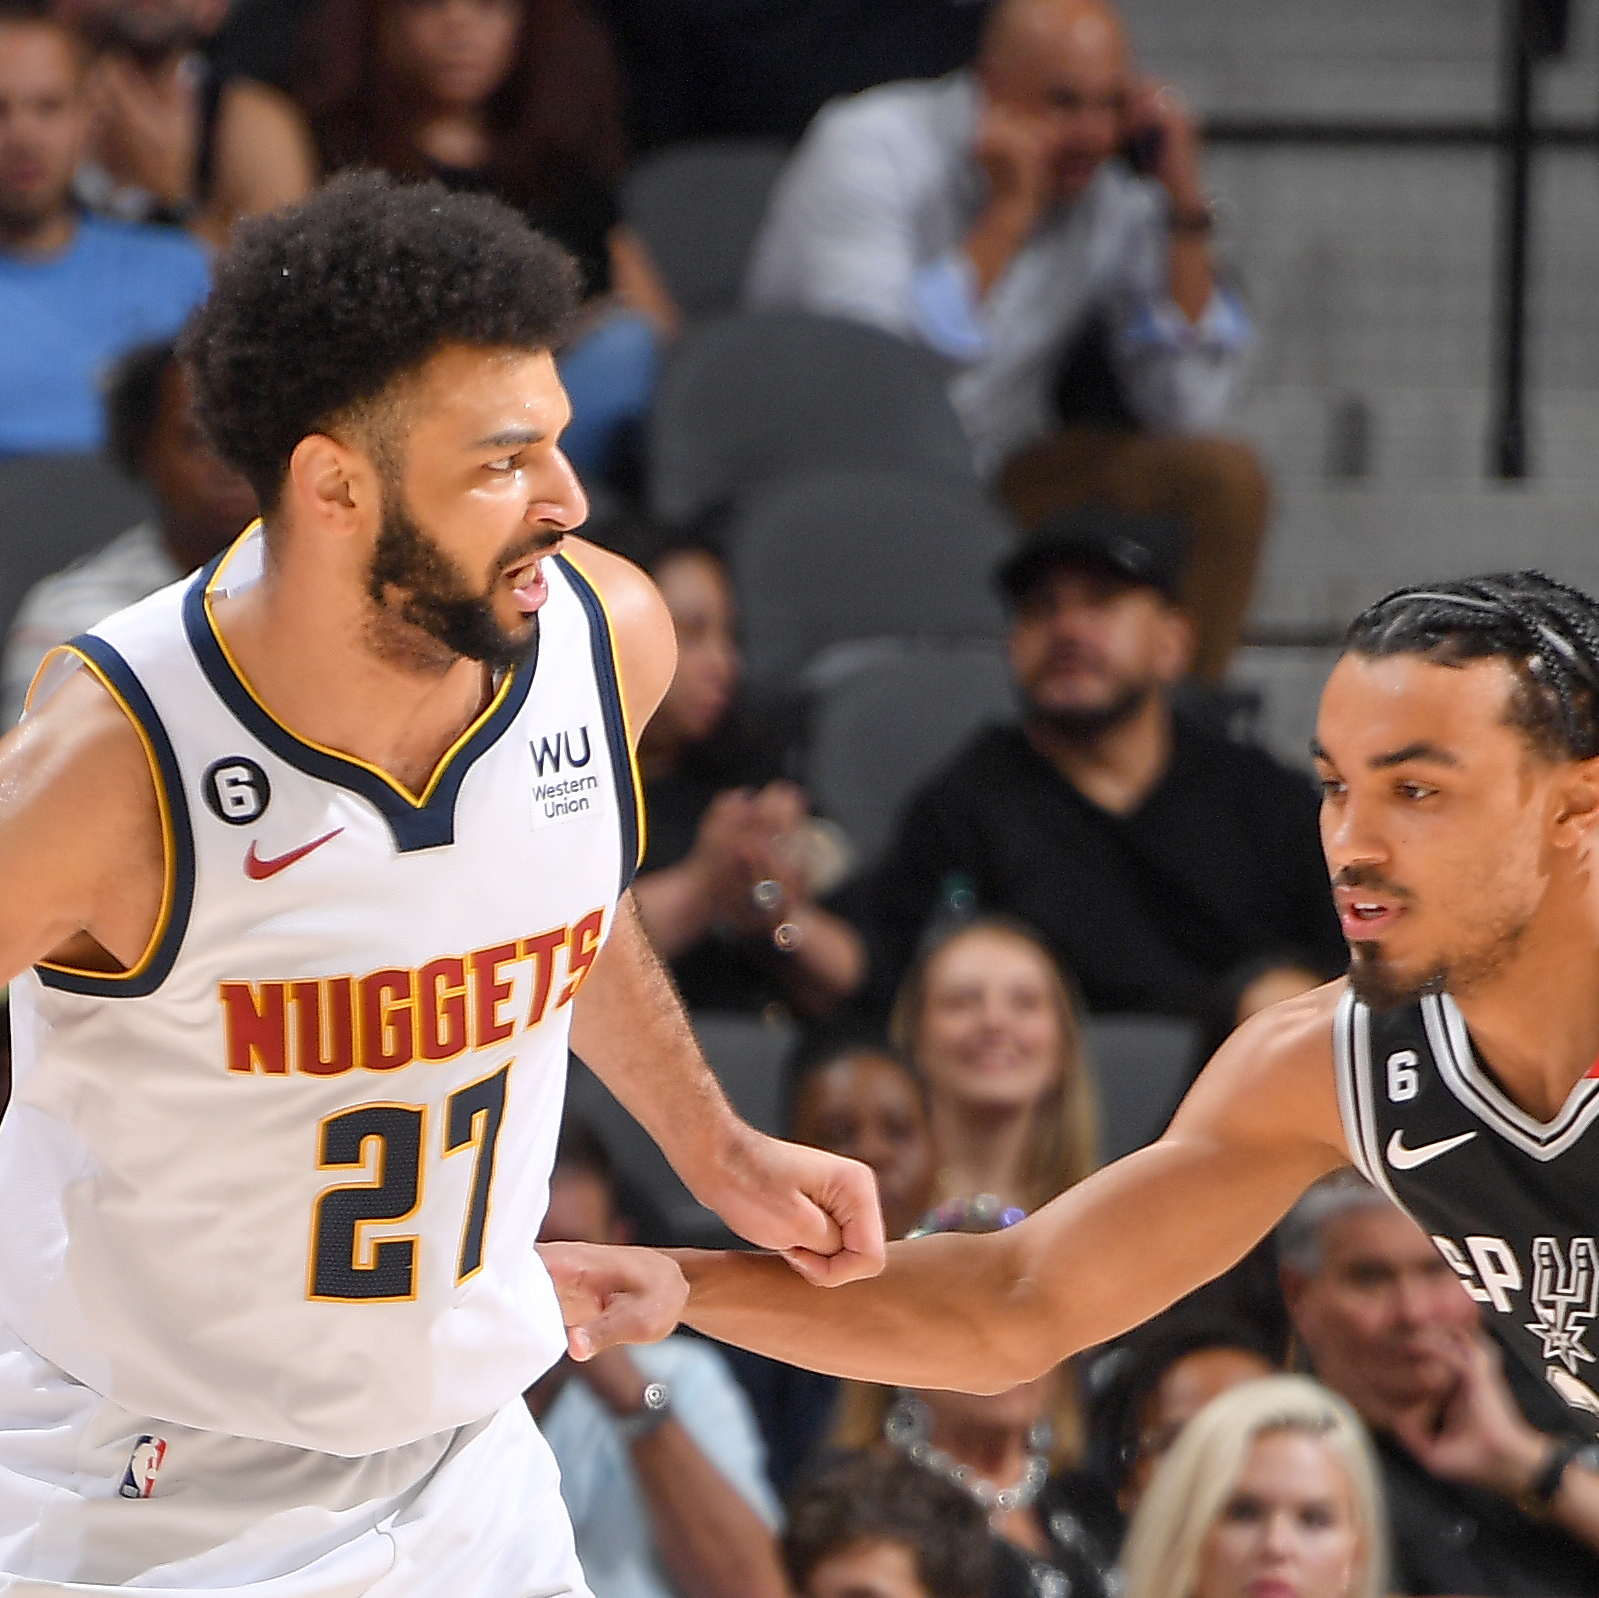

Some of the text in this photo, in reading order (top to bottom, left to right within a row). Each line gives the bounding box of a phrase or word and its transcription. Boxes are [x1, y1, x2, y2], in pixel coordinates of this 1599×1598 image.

[528, 726, 591, 777] WU
[214, 766, 257, 817] 6
[532, 776, 598, 802] Western
[544, 797, 590, 818] Union
[217, 905, 605, 1080] NUGGETS
[1386, 1049, 1420, 1103] 6
[305, 1056, 516, 1304] 27
